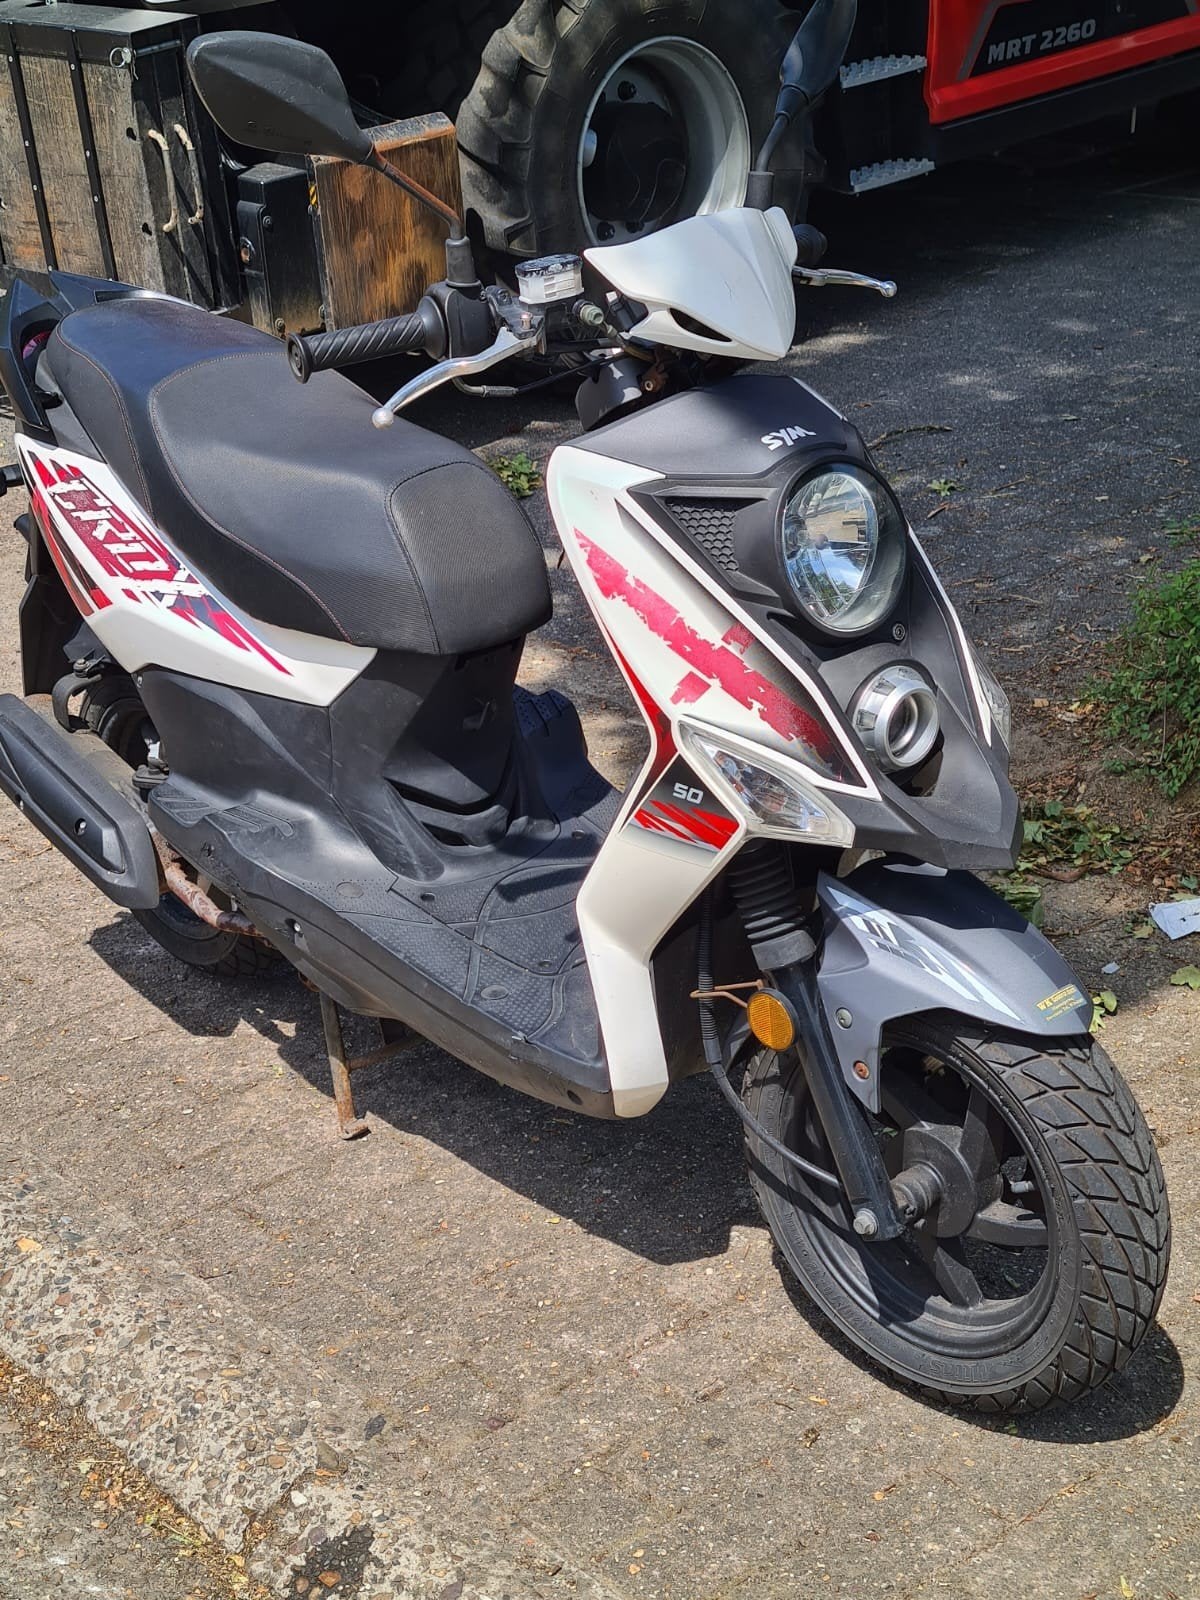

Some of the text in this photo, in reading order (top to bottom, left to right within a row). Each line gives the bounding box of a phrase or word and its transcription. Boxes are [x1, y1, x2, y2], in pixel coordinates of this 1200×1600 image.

[987, 18, 1097, 65] MRT 2260
[760, 425, 817, 451] SYM
[672, 782, 704, 805] 50
